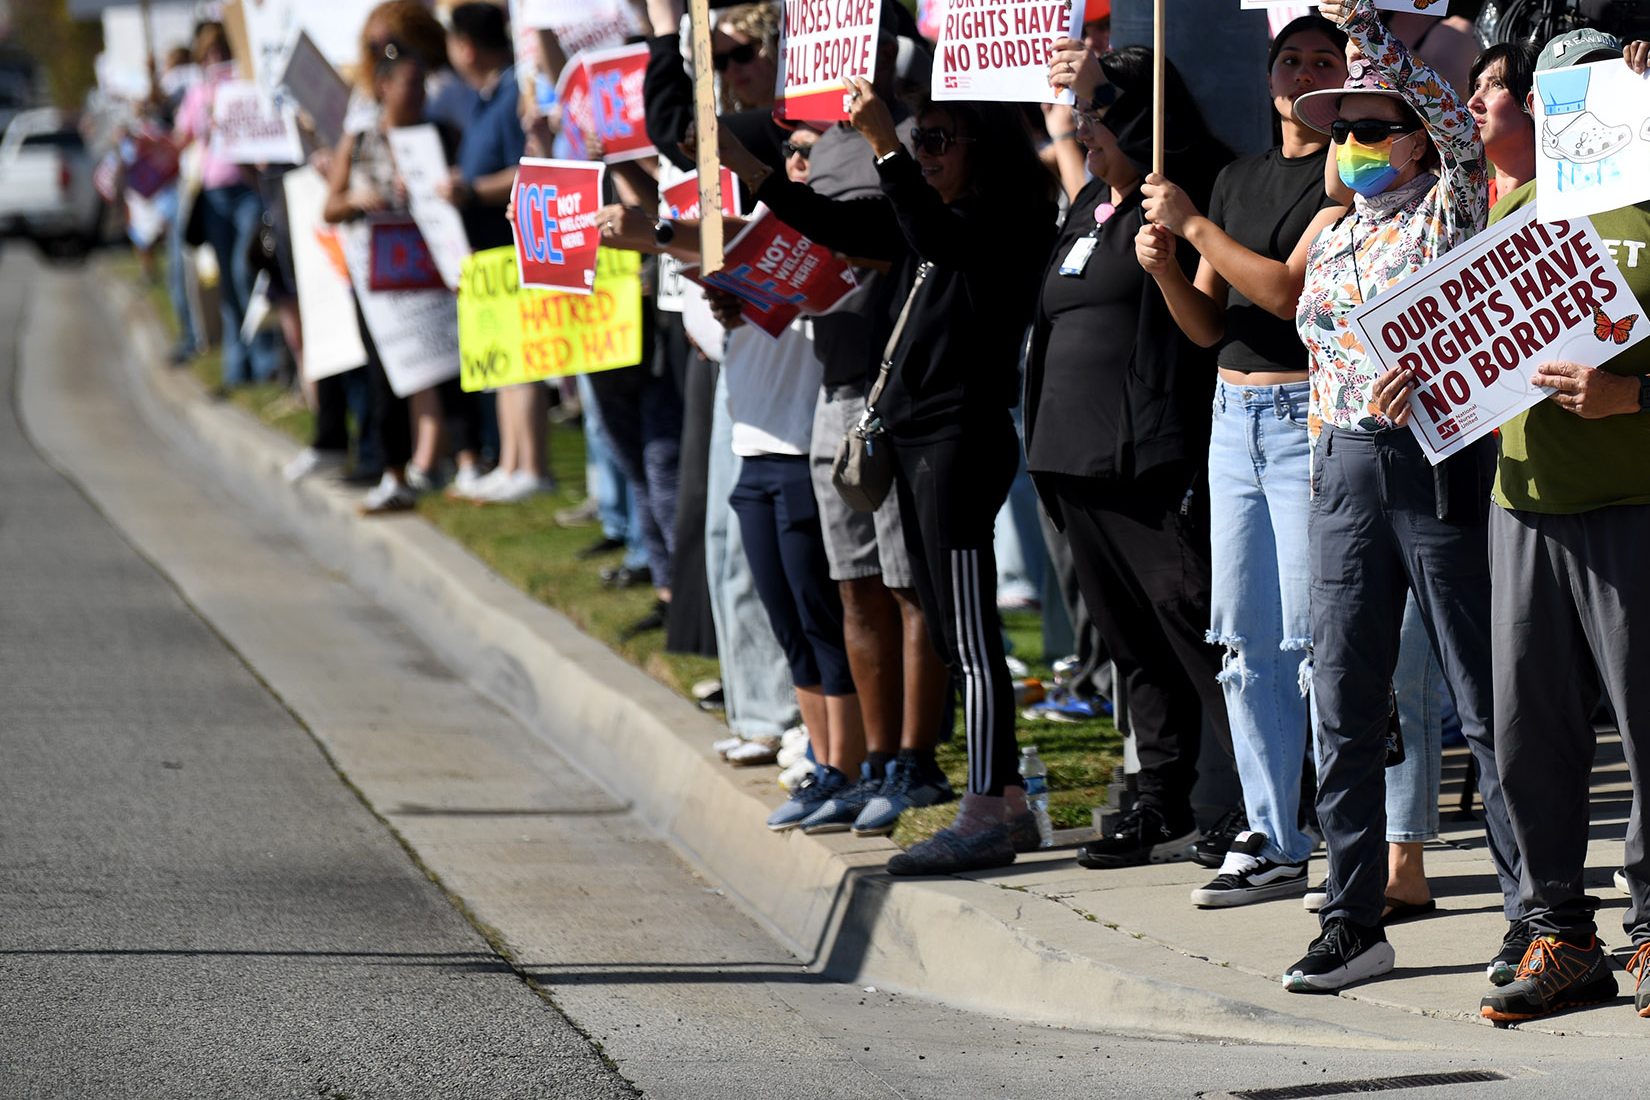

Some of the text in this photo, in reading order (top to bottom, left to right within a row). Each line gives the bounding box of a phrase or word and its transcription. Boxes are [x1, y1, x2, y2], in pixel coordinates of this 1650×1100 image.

[945, 5, 1070, 40] RIGHTS HAVE
[784, 34, 872, 88] ALL PEOPLE
[944, 36, 1069, 72] NO BORDER
[516, 182, 565, 265] ICE
[557, 192, 582, 217] NOT
[756, 234, 792, 274] NOT
[788, 253, 820, 290] HERE!
[520, 290, 617, 333] HATRED
[1381, 295, 1447, 353] OUR
[1397, 230, 1600, 389] RIGHTS HAVE
[581, 322, 632, 367] HAT
[1418, 266, 1618, 424] NO BORDERS
[1456, 403, 1478, 419] National
[1458, 411, 1477, 424] Nurses
[1460, 416, 1479, 429] United
